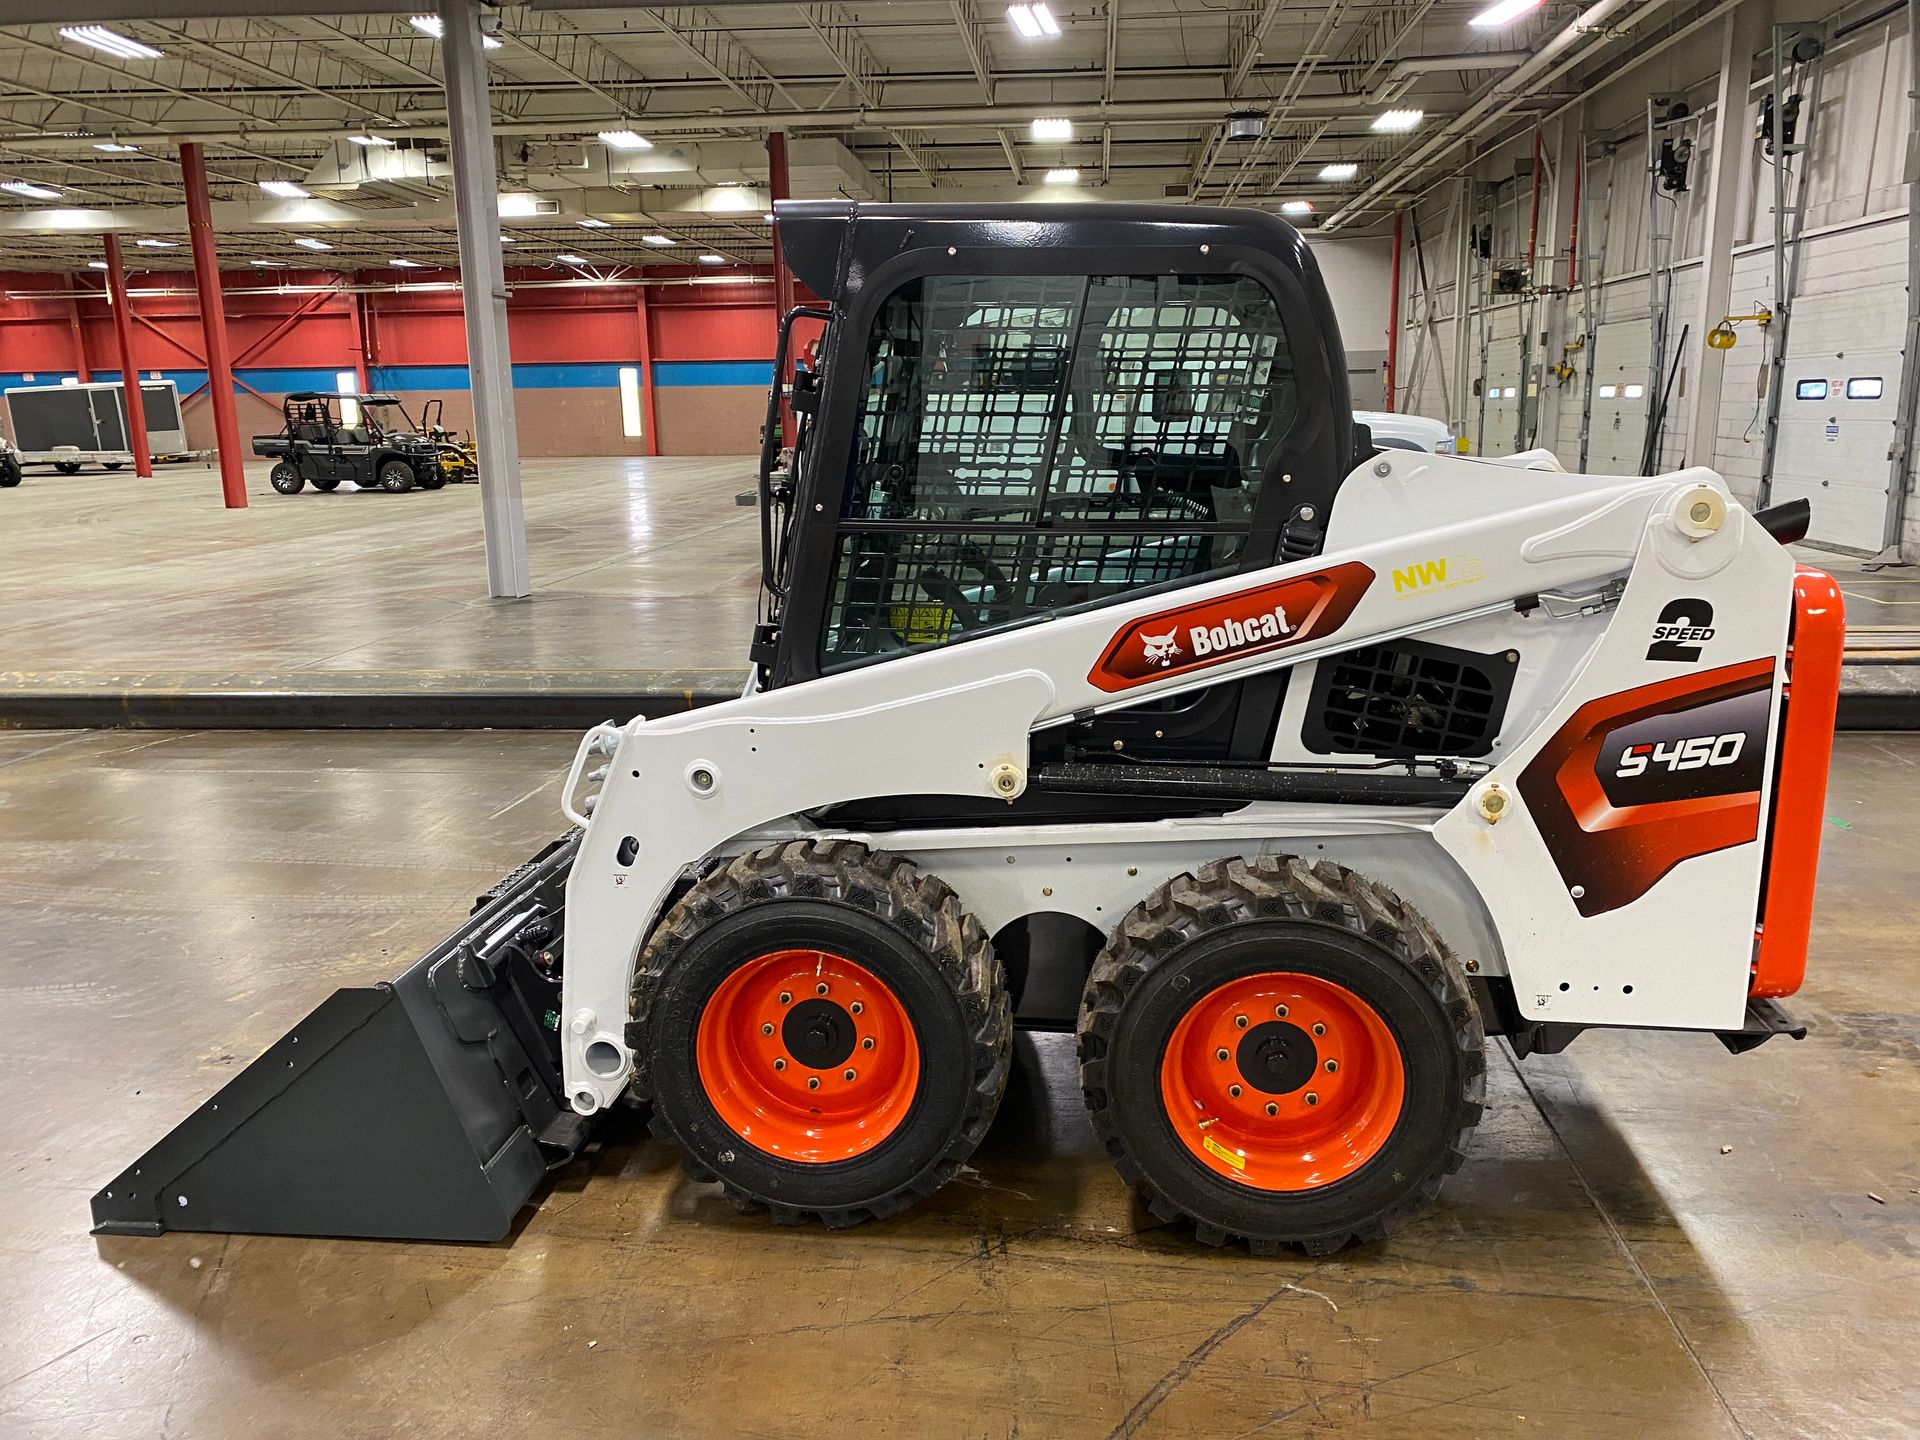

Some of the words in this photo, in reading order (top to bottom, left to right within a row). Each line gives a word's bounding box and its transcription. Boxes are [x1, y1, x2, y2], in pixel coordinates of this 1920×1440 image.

[1392, 557, 1447, 593] NW
[1189, 605, 1291, 657] Bobcat
[1645, 598, 1714, 662] 2
[1652, 626, 1716, 641] SPEED
[1616, 732, 1747, 778] S450
